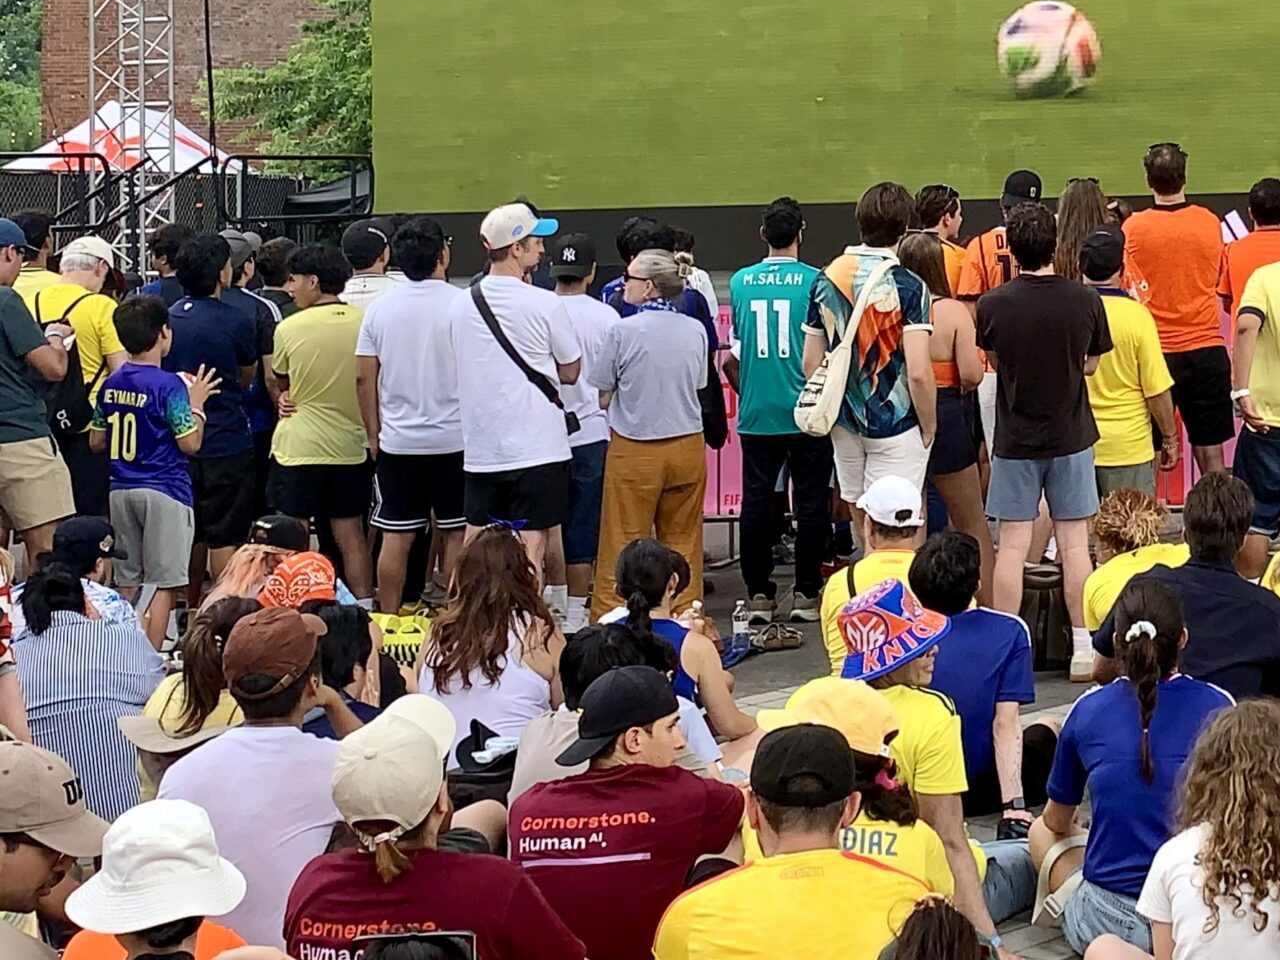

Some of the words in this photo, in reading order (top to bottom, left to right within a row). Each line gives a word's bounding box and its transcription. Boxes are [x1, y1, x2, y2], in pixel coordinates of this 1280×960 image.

[743, 272, 803, 286] M.SALAH
[750, 299, 791, 359] 11
[107, 411, 137, 462] 10
[724, 494, 743, 506] FIF
[862, 623, 937, 674] KNIC
[520, 811, 656, 832] Cornerstone.
[842, 827, 898, 857] DIAZ
